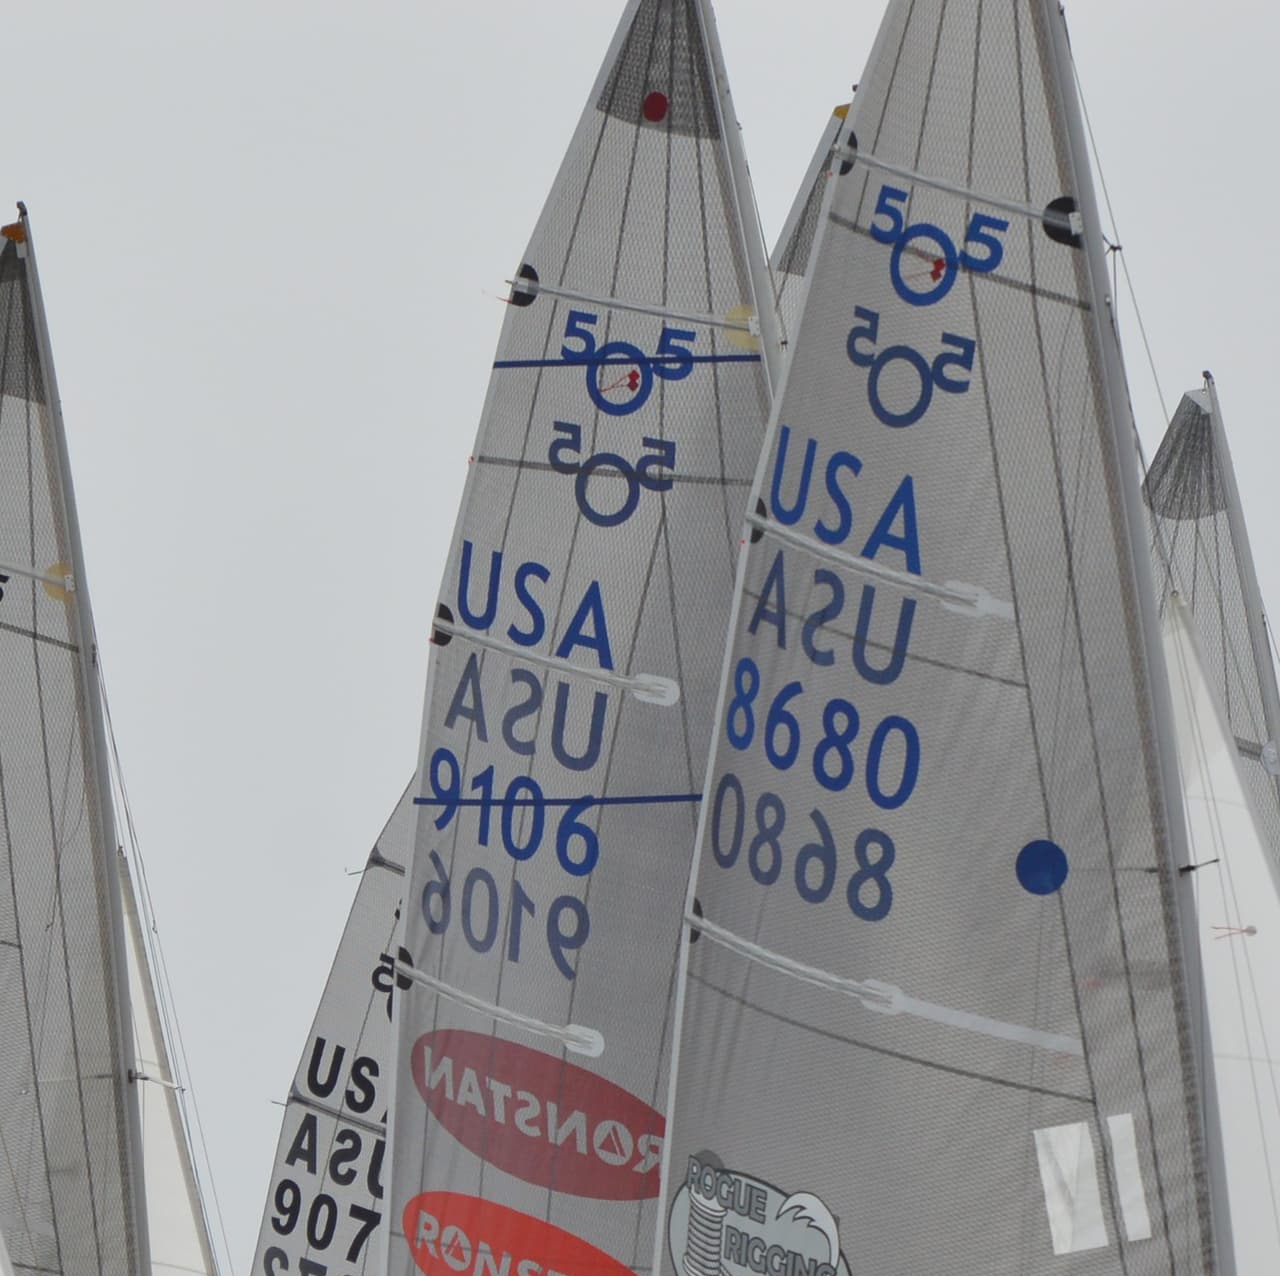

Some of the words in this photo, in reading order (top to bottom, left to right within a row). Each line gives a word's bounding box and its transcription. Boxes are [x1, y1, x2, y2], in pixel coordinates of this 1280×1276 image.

[769, 425, 921, 574] USA
[456, 540, 613, 671] USA
[726, 658, 920, 810] 8680
[430, 748, 599, 876] 9106
[307, 1036, 387, 1124] US
[272, 1179, 382, 1264] 907
[687, 1155, 768, 1224] ROGUE
